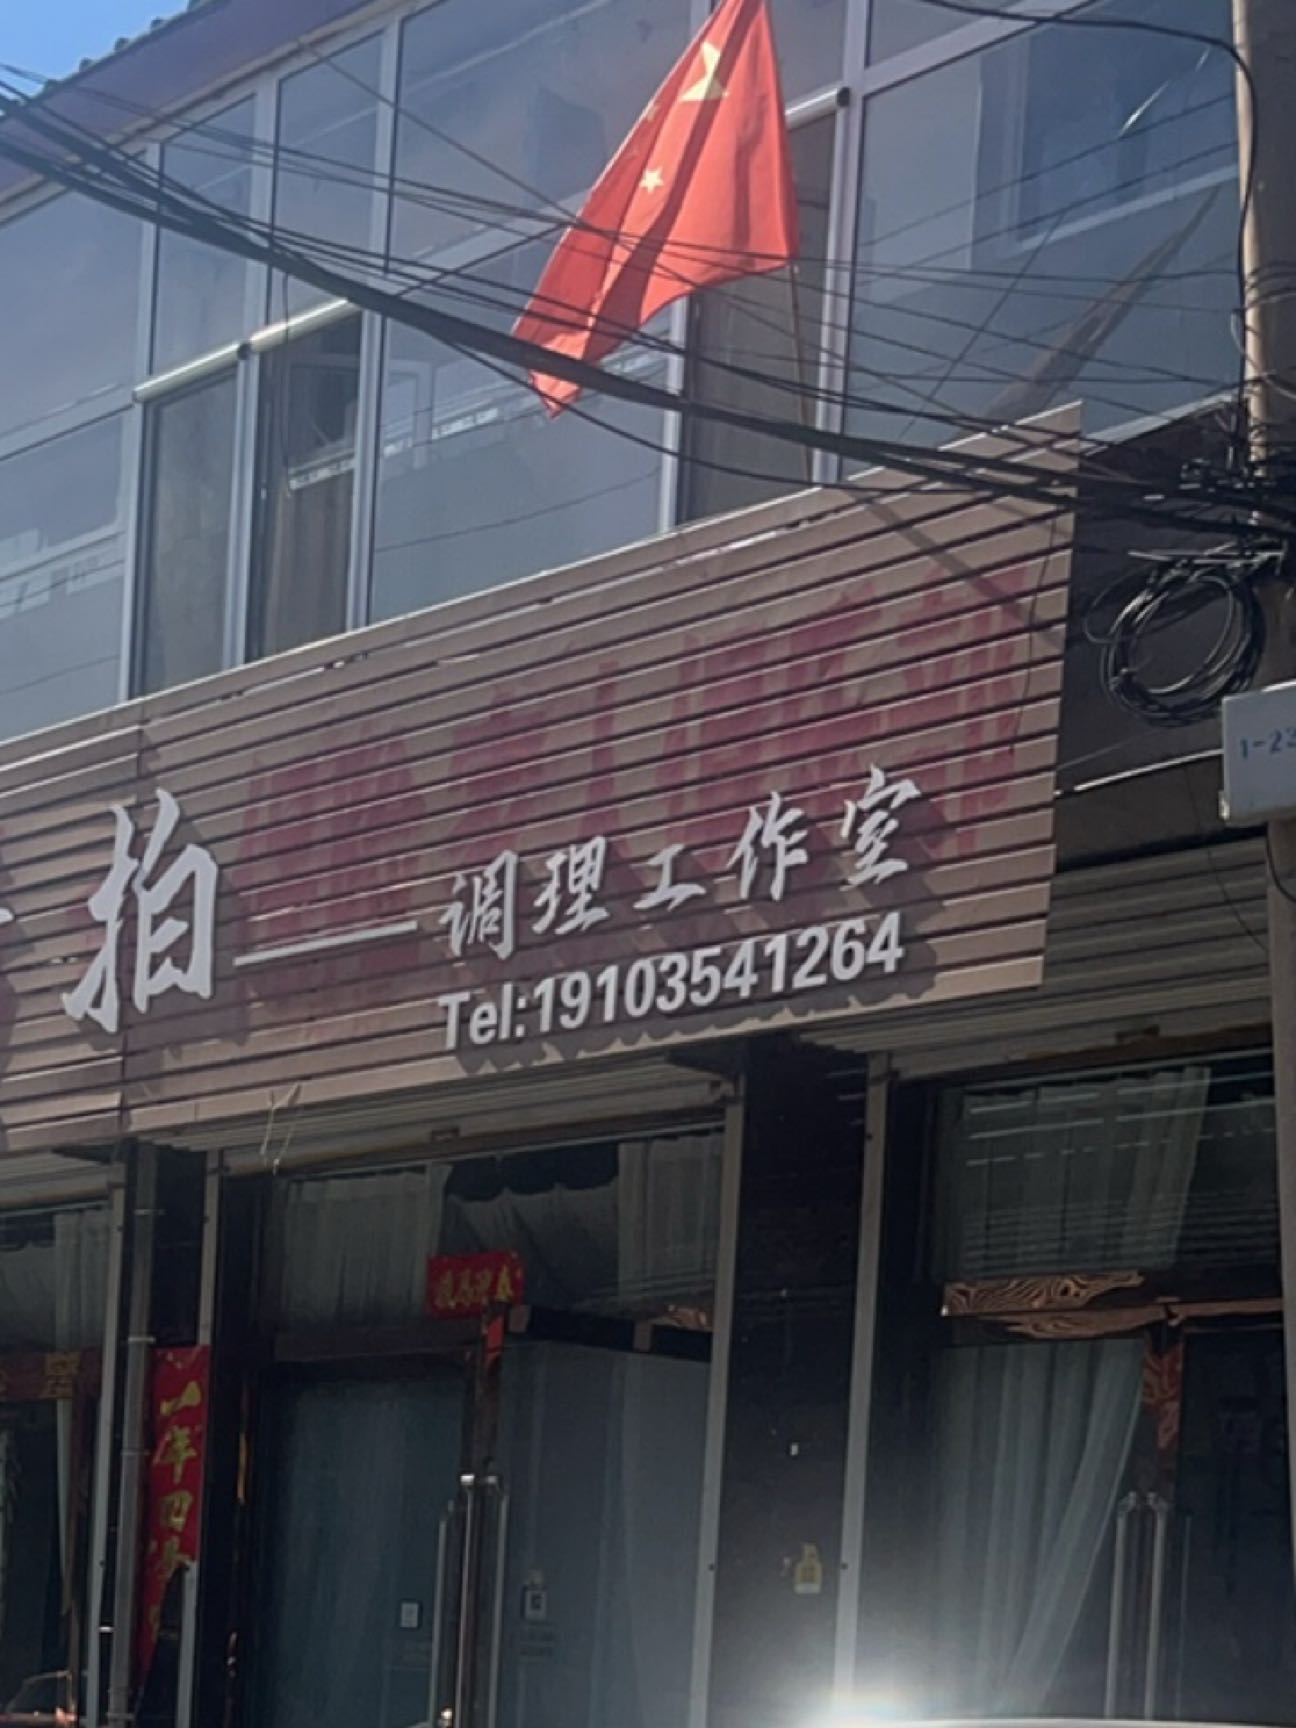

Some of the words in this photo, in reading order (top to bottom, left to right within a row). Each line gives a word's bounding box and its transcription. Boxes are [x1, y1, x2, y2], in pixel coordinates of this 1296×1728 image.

[439, 763, 921, 959] 调理工作室
[438, 912, 904, 1050] Tel:19103541264
